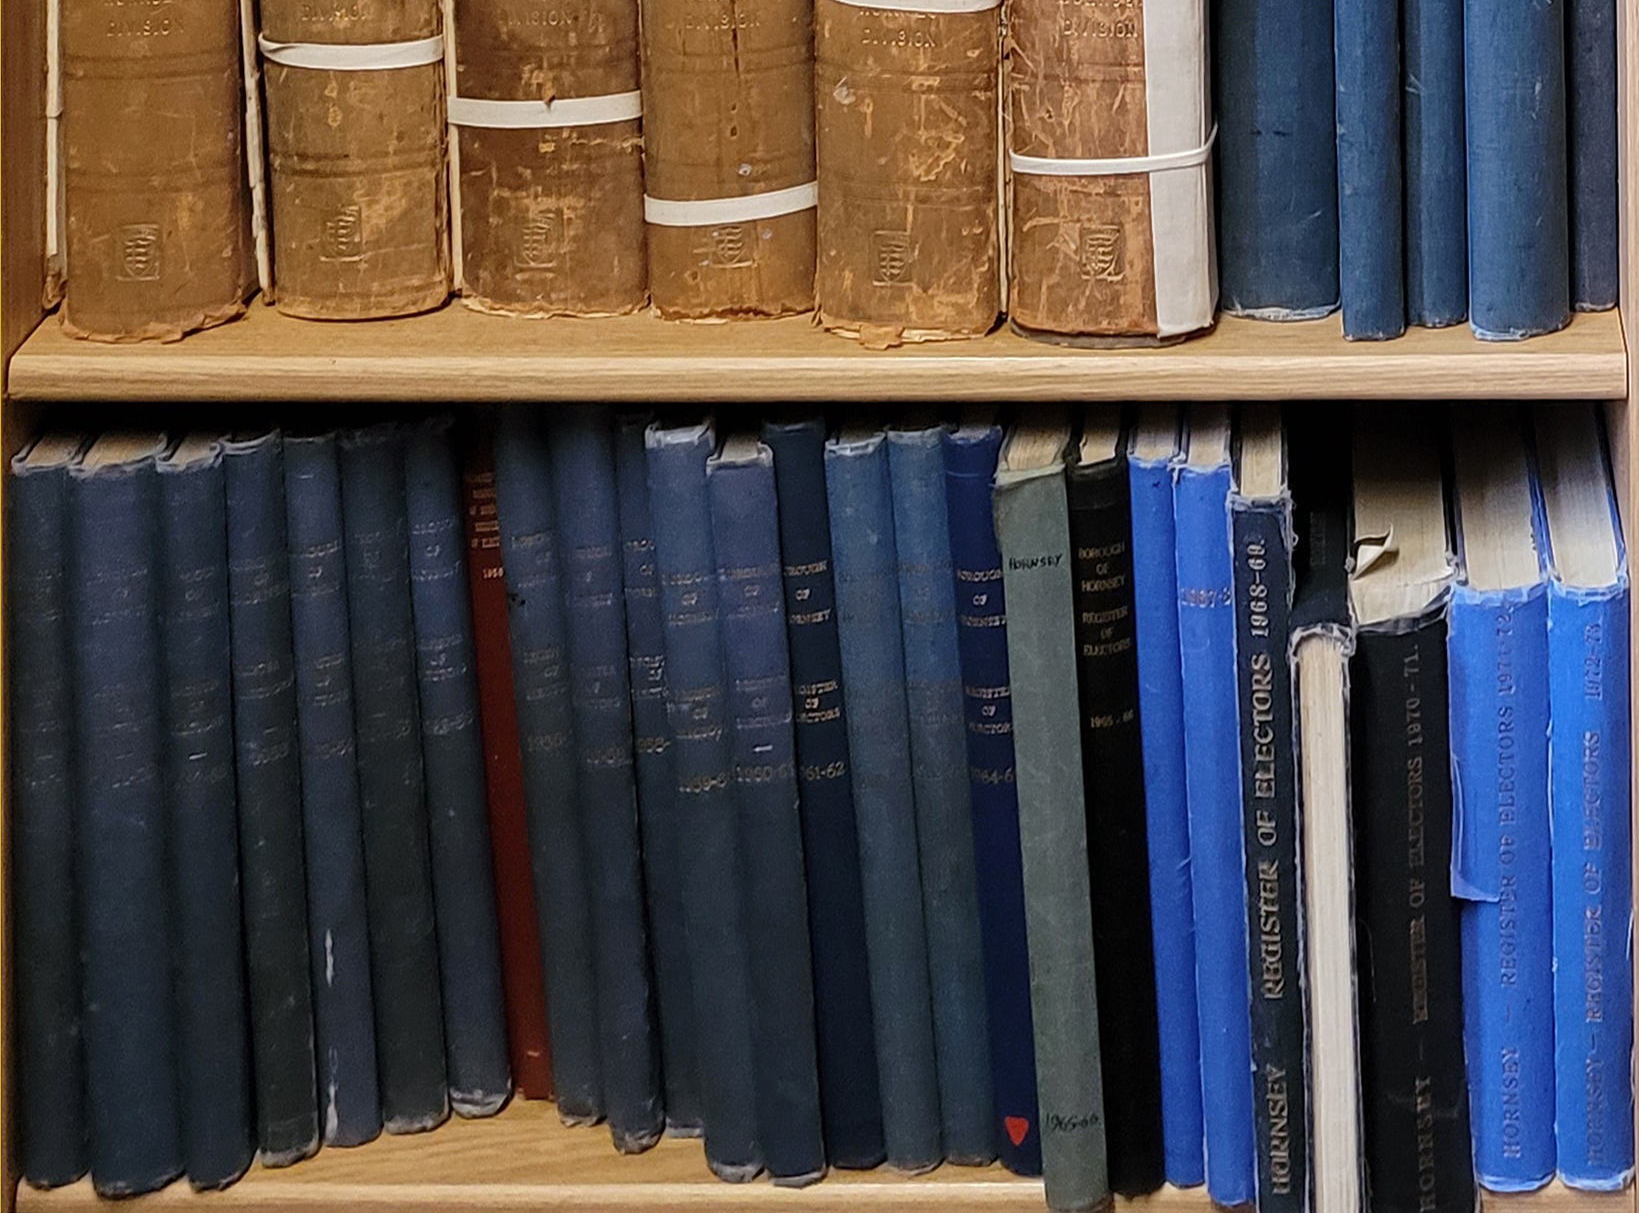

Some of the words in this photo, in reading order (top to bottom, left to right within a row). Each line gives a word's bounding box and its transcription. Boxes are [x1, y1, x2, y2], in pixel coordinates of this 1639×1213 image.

[1250, 653, 1276, 799] ELECTORS
[1255, 810, 1278, 847] OF
[1257, 858, 1285, 999] REGISTER
[1264, 1062, 1291, 1195] HORNSEY
